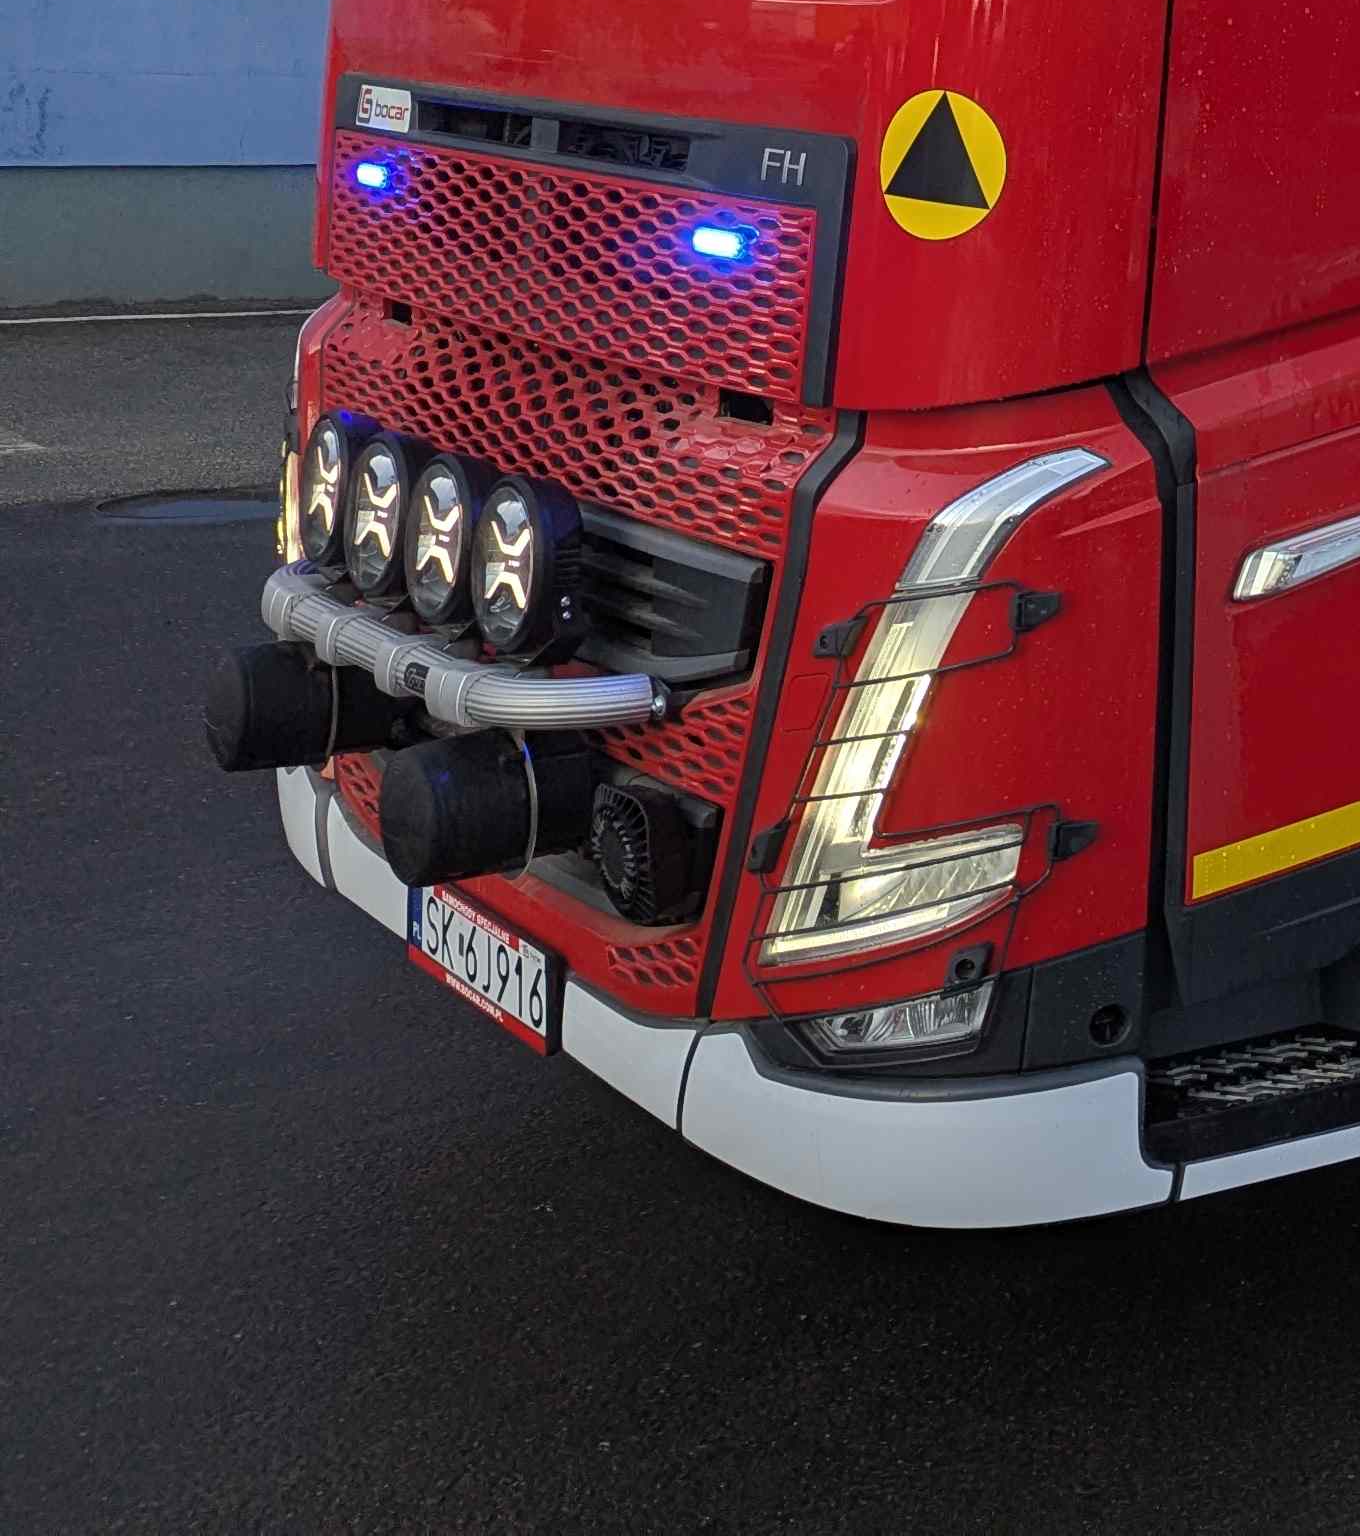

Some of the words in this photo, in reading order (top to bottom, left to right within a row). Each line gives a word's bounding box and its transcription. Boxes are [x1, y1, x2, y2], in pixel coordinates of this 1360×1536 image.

[375, 96, 409, 121] bocar
[761, 148, 806, 186] FH
[412, 920, 422, 941] PL
[426, 896, 455, 971] SK
[465, 925, 544, 1029] 6J916
